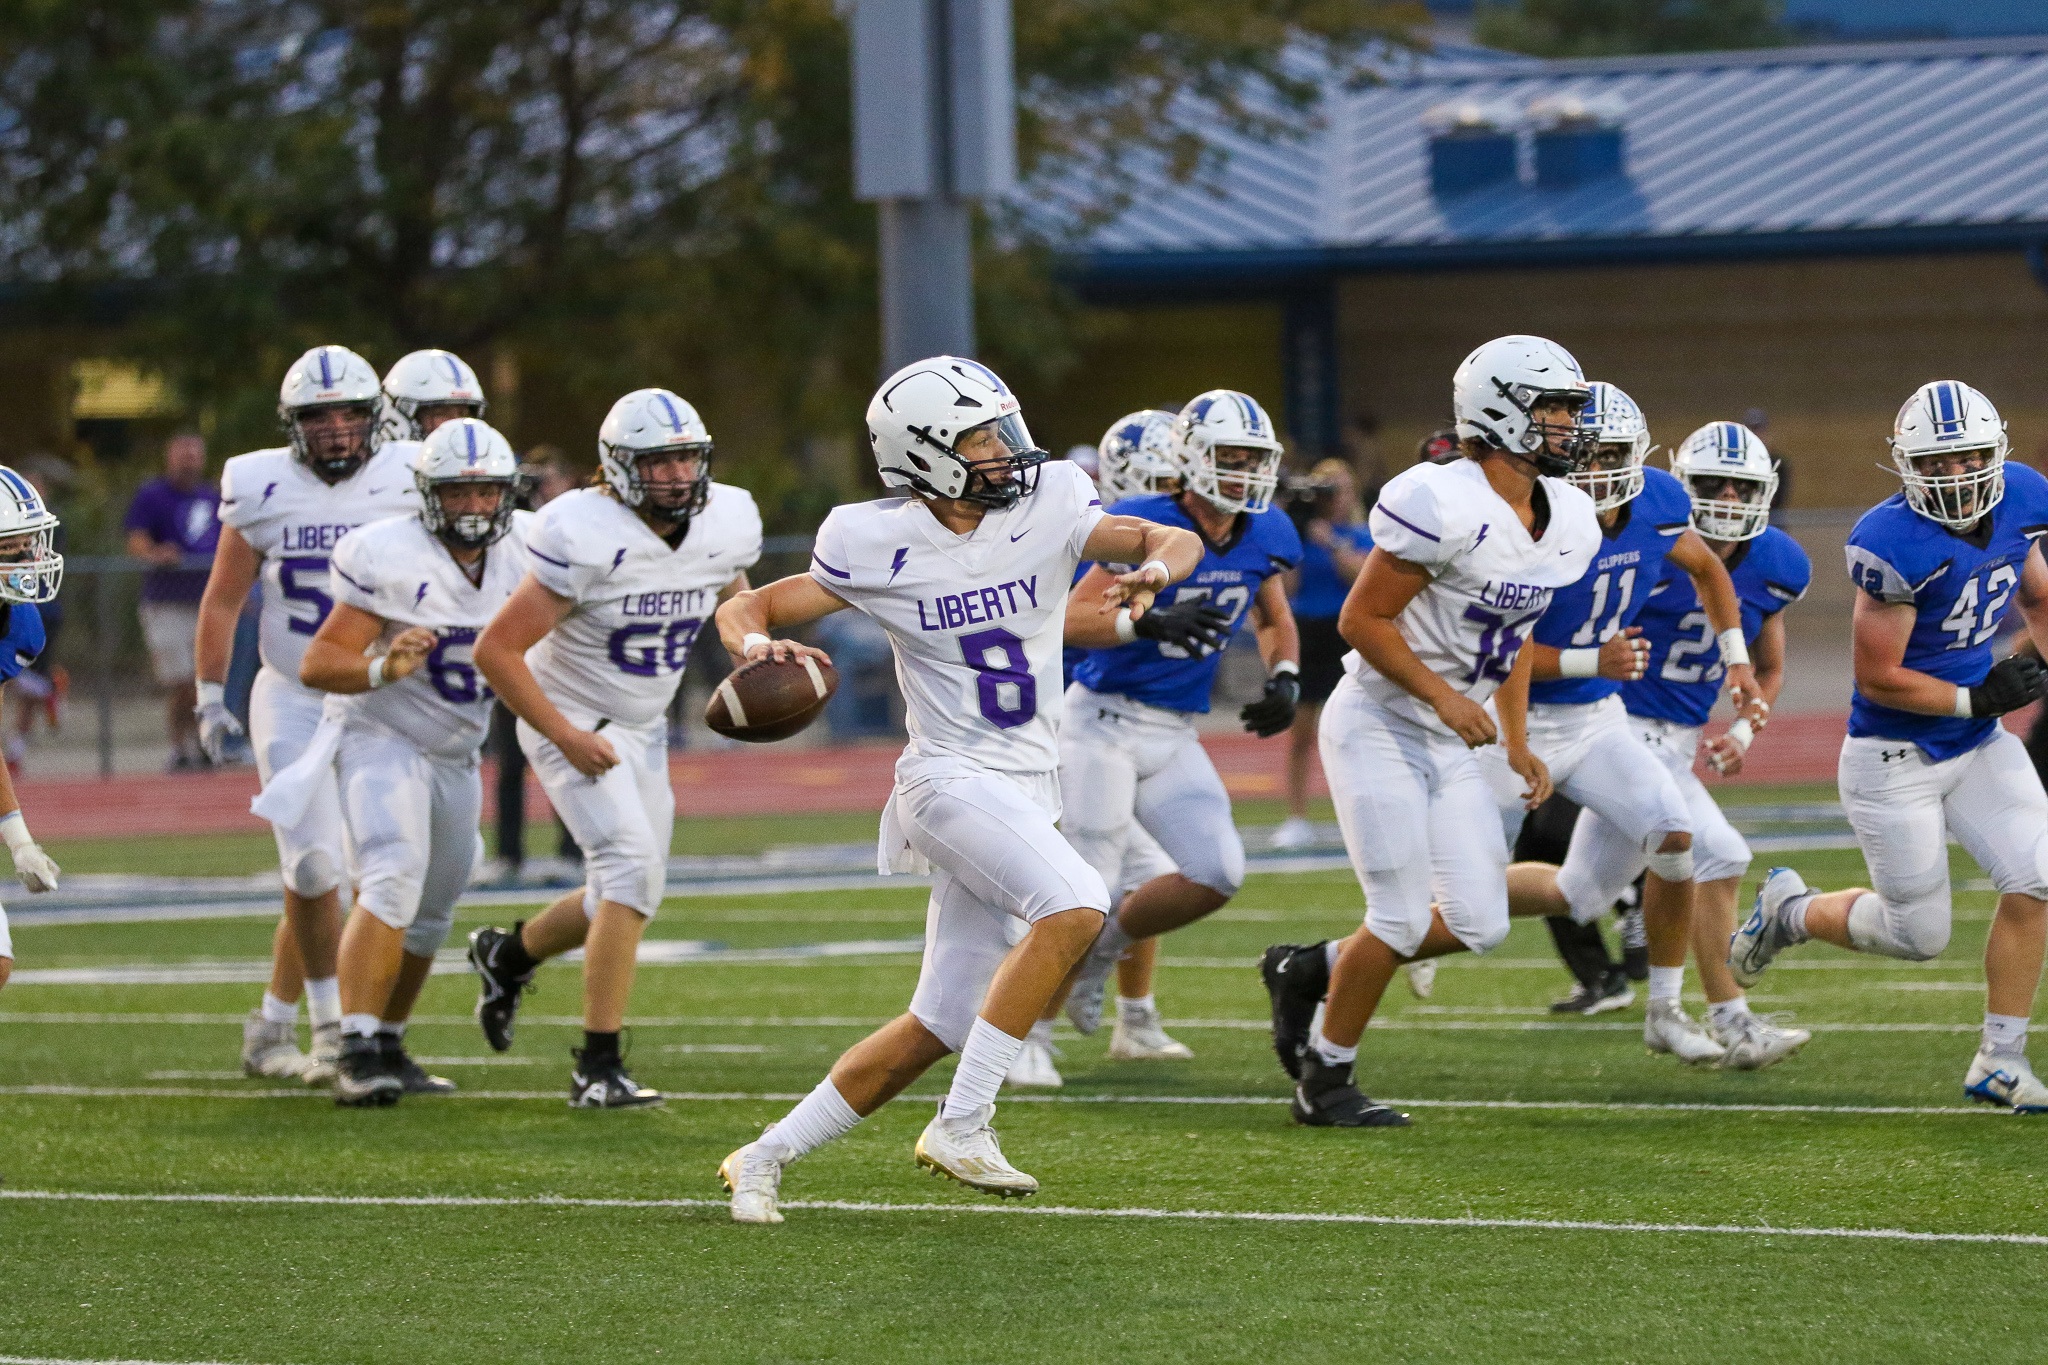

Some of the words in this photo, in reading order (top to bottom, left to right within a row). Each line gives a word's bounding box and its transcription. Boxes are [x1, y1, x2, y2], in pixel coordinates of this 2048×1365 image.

[283, 525, 362, 551] LIBER
[1598, 550, 1641, 570] CLIPPERS
[622, 589, 705, 616] LIBERTY
[917, 575, 1038, 631] LIBERTY
[1571, 567, 1637, 646] 11
[1941, 564, 2018, 650] 42
[955, 625, 1038, 730] 8
